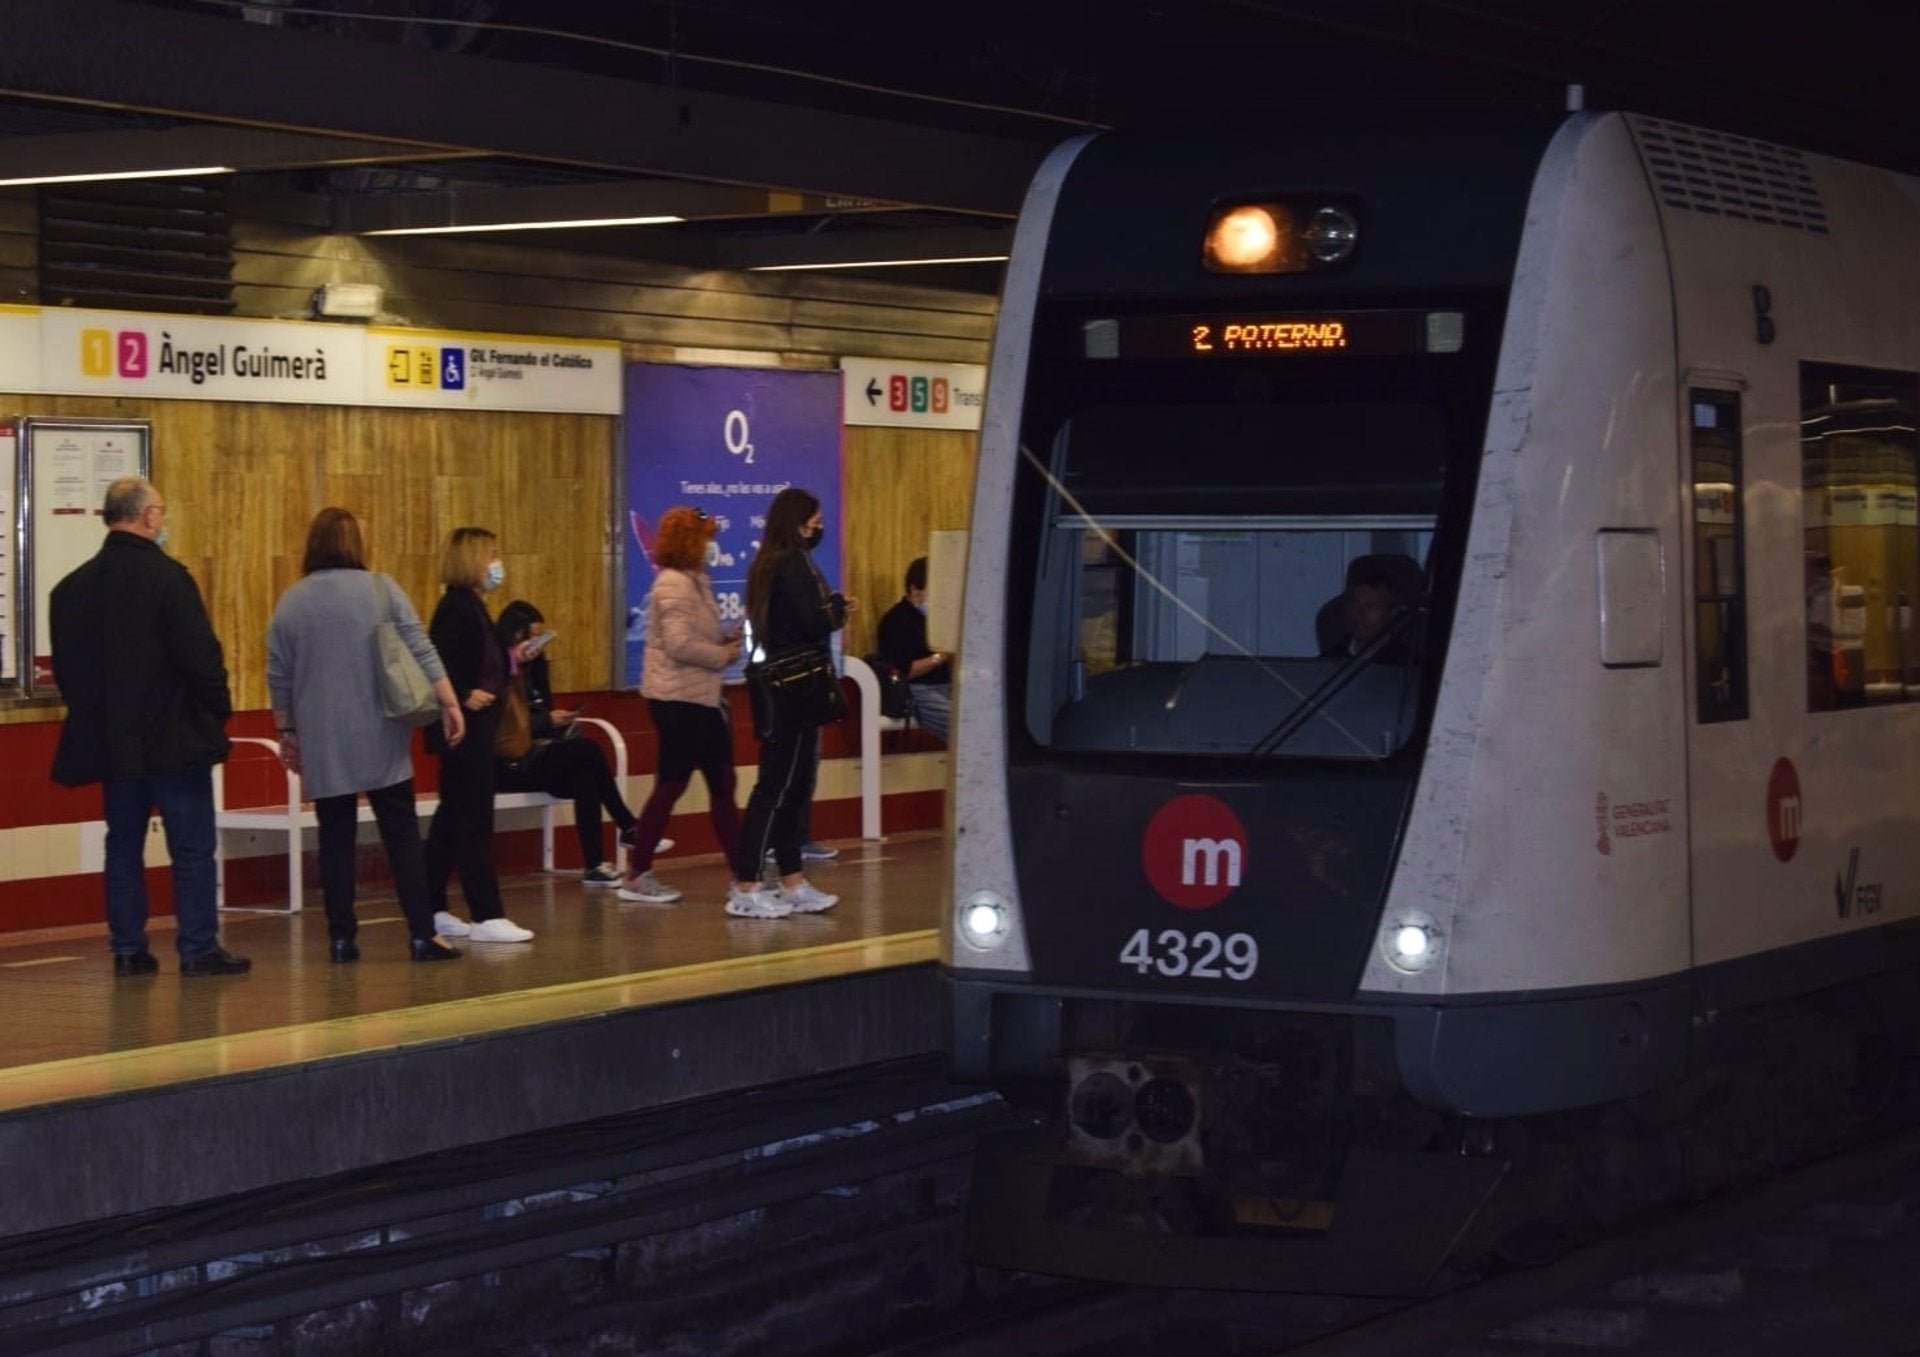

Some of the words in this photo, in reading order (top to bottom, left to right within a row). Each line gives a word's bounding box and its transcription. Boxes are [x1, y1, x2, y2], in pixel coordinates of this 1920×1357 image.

[1193, 326, 1212, 349] 2
[1753, 285, 1776, 345] B
[159, 331, 226, 385] Àngel
[232, 345, 327, 380] Guimerà
[489, 349, 538, 367] Fernando
[540, 353, 550, 366] el
[1181, 837, 1242, 887] m
[1119, 928, 1259, 981] 4329
